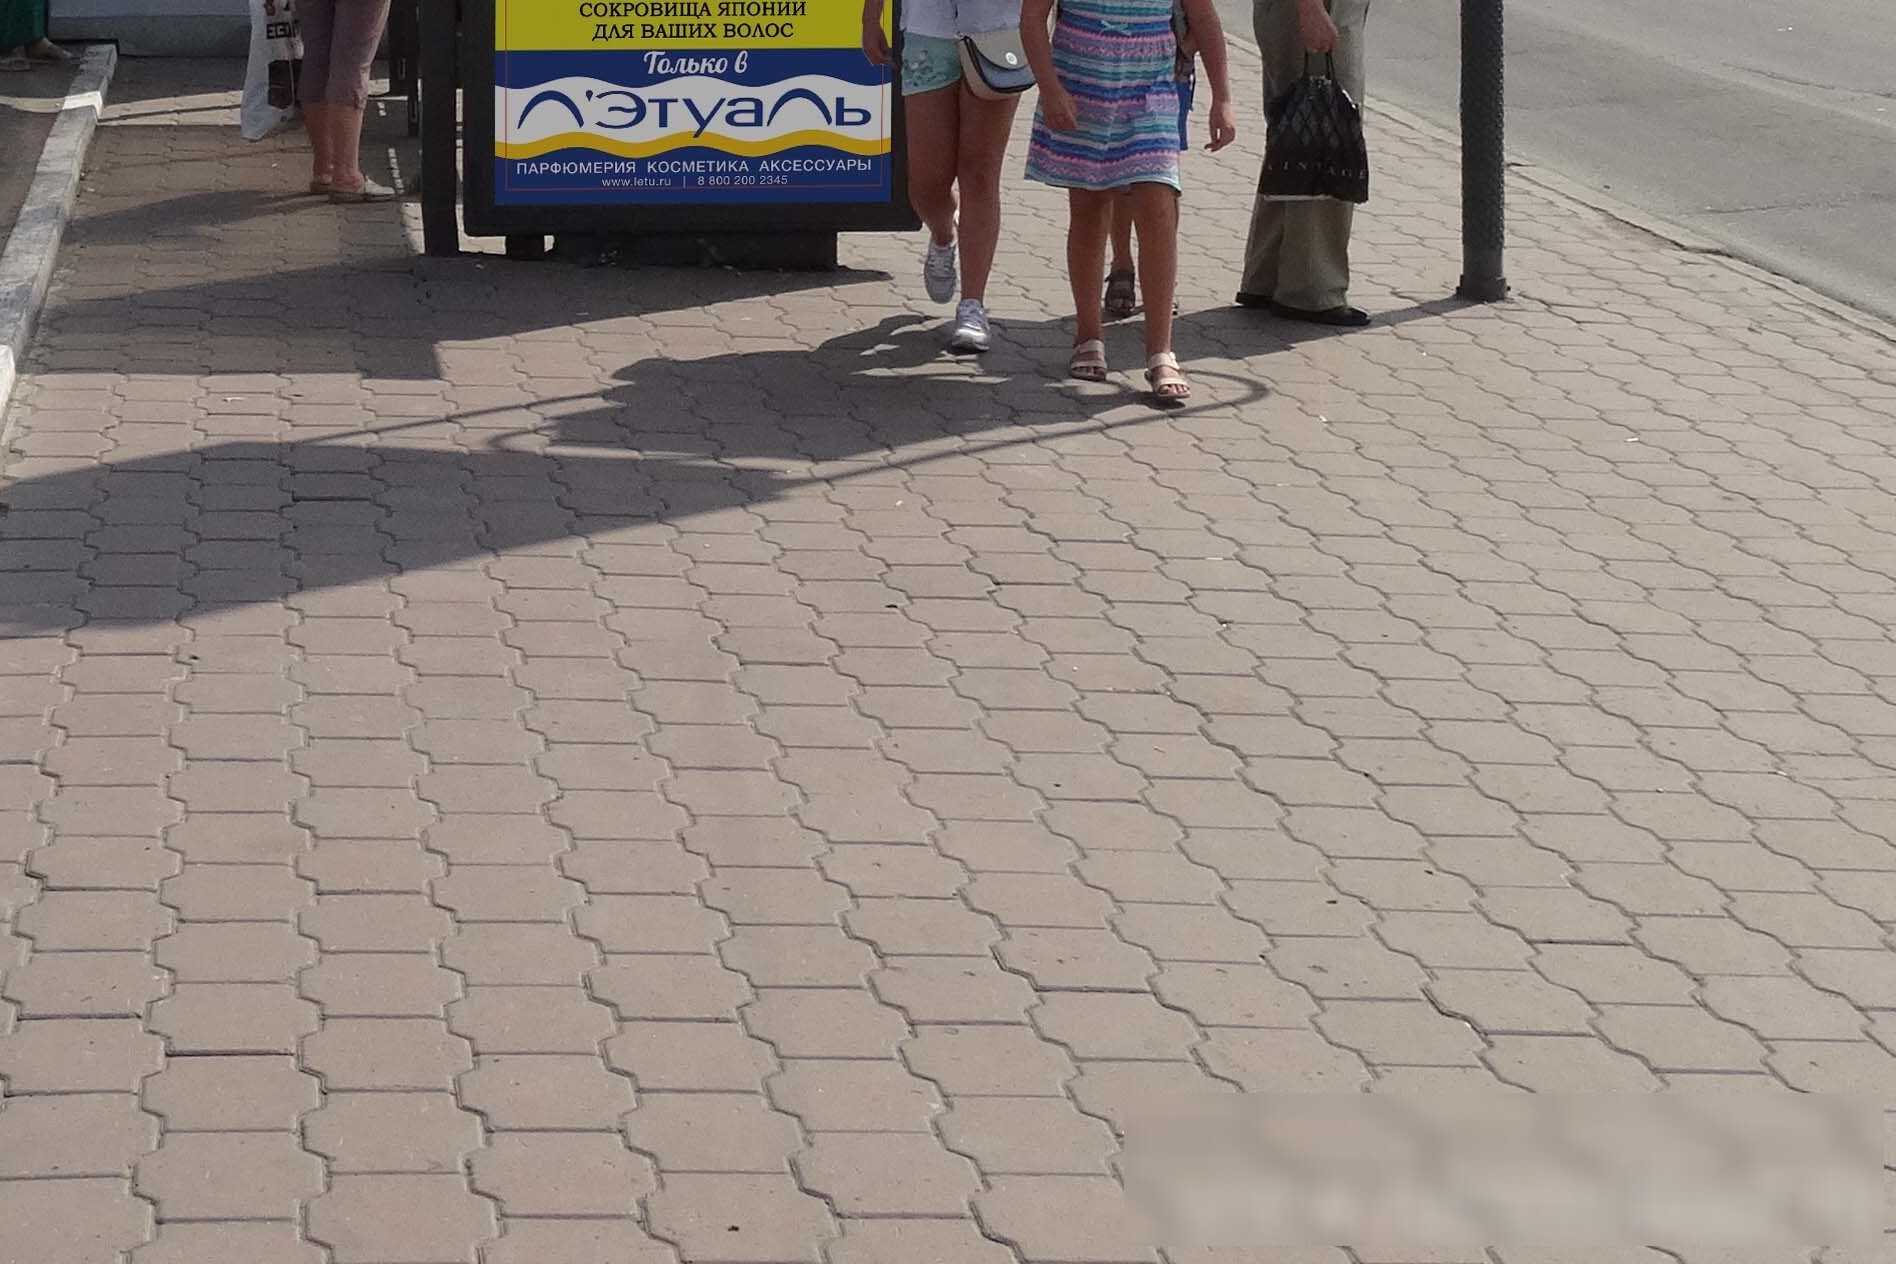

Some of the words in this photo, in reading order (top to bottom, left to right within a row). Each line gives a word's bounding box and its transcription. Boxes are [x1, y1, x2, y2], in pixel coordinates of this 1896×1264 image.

[579, 1, 712, 20] СОКРОВИЩА
[717, 1, 807, 17] ЯПОНИИ
[592, 23, 635, 42] ДЛЯ
[641, 23, 717, 39] ВАШИХ
[723, 23, 794, 39] ВОЛОС
[643, 51, 729, 76] Только
[733, 51, 748, 74] в
[516, 160, 637, 175] ПАРФЮМЕРИЯ
[647, 160, 750, 174] КОСМЕТИКА
[759, 158, 872, 172] АКСЕССУАРЫ
[601, 177, 672, 189] www.letu.ru
[697, 176, 705, 186] 8
[708, 176, 731, 186] 800
[733, 176, 757, 186] 200
[759, 175, 788, 185] 2345
